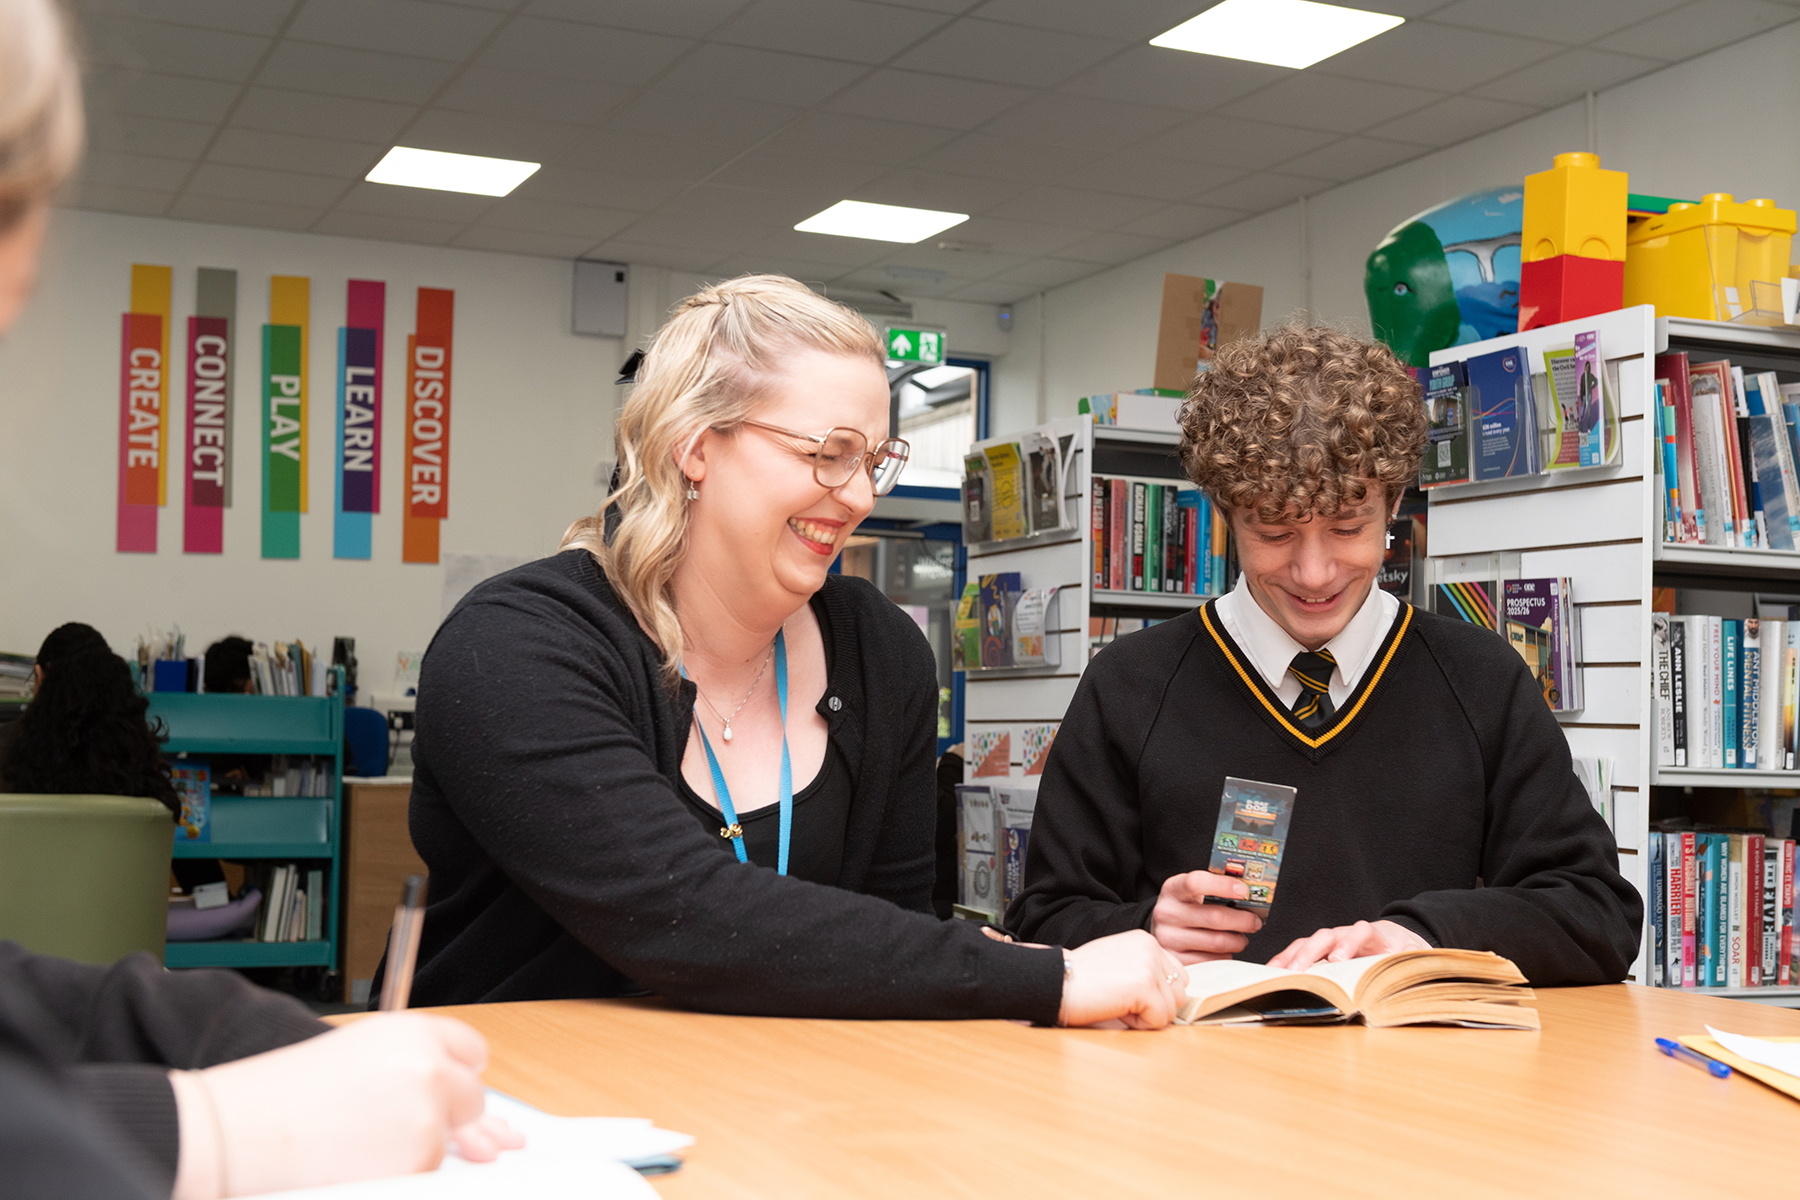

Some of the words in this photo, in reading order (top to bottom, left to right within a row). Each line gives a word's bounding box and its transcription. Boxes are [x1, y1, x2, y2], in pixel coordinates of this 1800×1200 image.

[129, 347, 162, 469] CREATE
[192, 334, 227, 487] CONNECT
[270, 374, 301, 461] PLAY
[343, 366, 376, 472] LEARN
[411, 345, 446, 505] DISCOVER
[1134, 485, 1144, 522] RICHARD
[1134, 523, 1143, 554] OSMAN
[1377, 569, 1408, 584] etsky
[1506, 597, 1546, 607] PROSPECTUS
[1506, 606, 1530, 616] 2025/26
[1659, 650, 1669, 670] THE
[1744, 652, 1752, 701] MENTAL
[1660, 671, 1670, 700] CHIEF
[1742, 703, 1752, 750] FITNESS
[1752, 678, 1760, 749] MIDDLETON
[1246, 804, 1268, 812] DOG
[1755, 838, 1759, 849] ON
[1785, 843, 1793, 874] HUNTING
[1670, 868, 1681, 916] HARRIER
[1685, 856, 1695, 895] PROBABLY
[1785, 875, 1792, 883] EL
[1763, 887, 1776, 932] FIVE
[1732, 937, 1740, 964] SOAR
